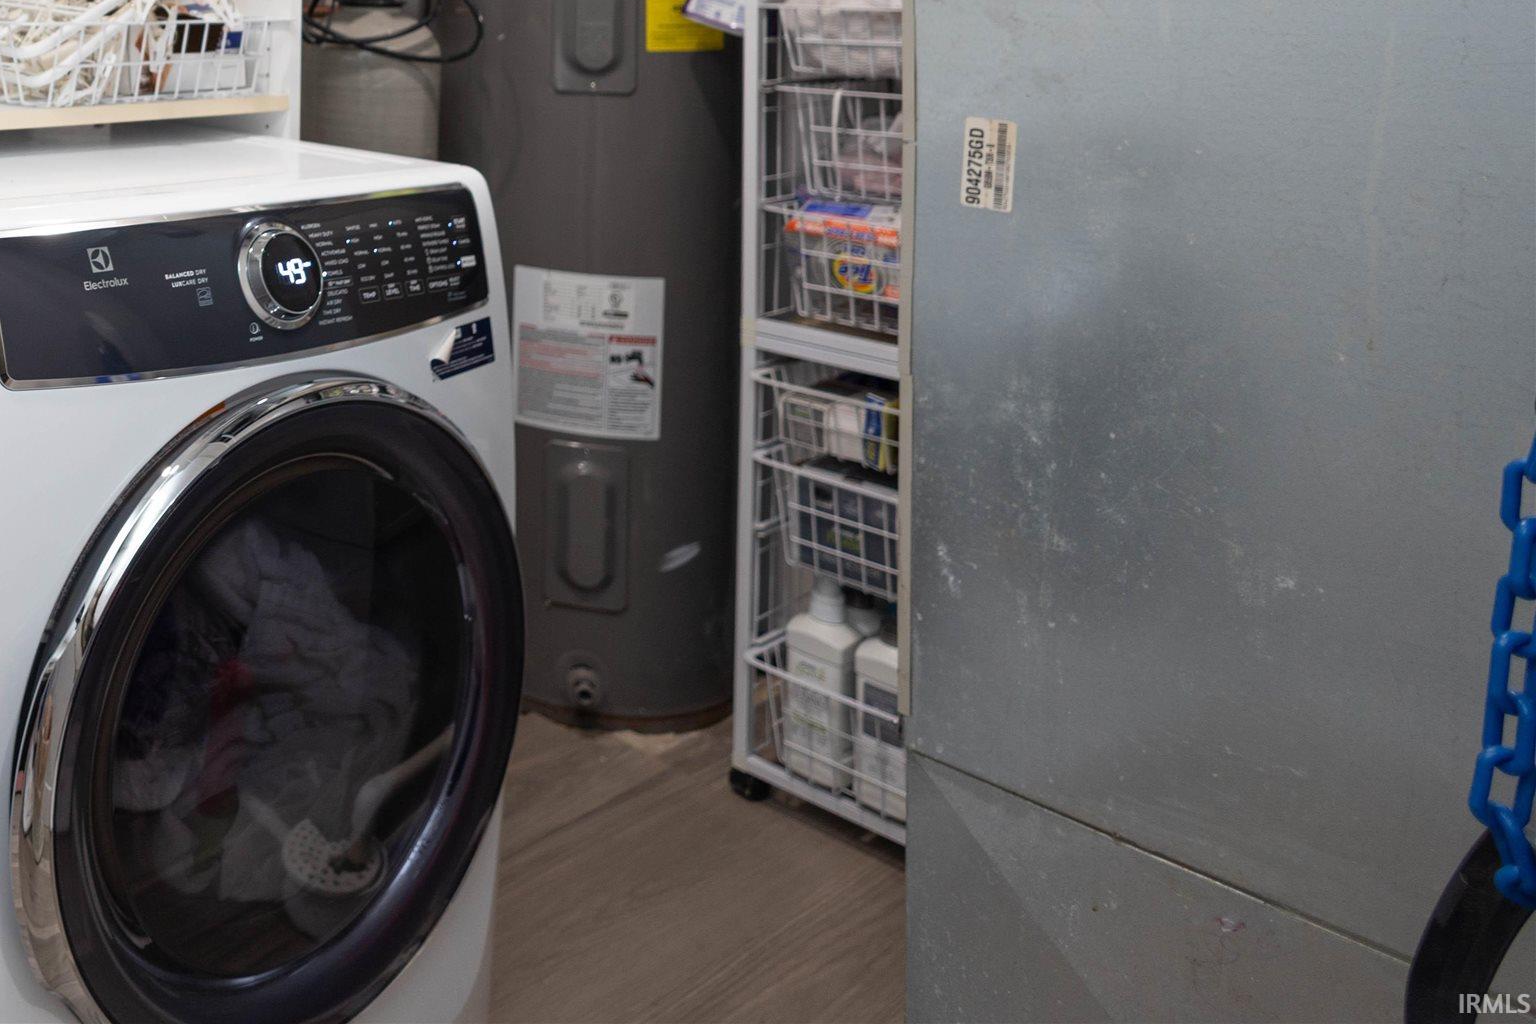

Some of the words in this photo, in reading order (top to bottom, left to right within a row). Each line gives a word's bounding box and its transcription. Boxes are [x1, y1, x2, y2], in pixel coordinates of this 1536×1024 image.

[966, 128, 985, 205] 904275GD
[164, 270, 195, 280] BALANCED
[84, 277, 129, 291] Electrolux
[172, 279, 196, 288] LUXCARE
